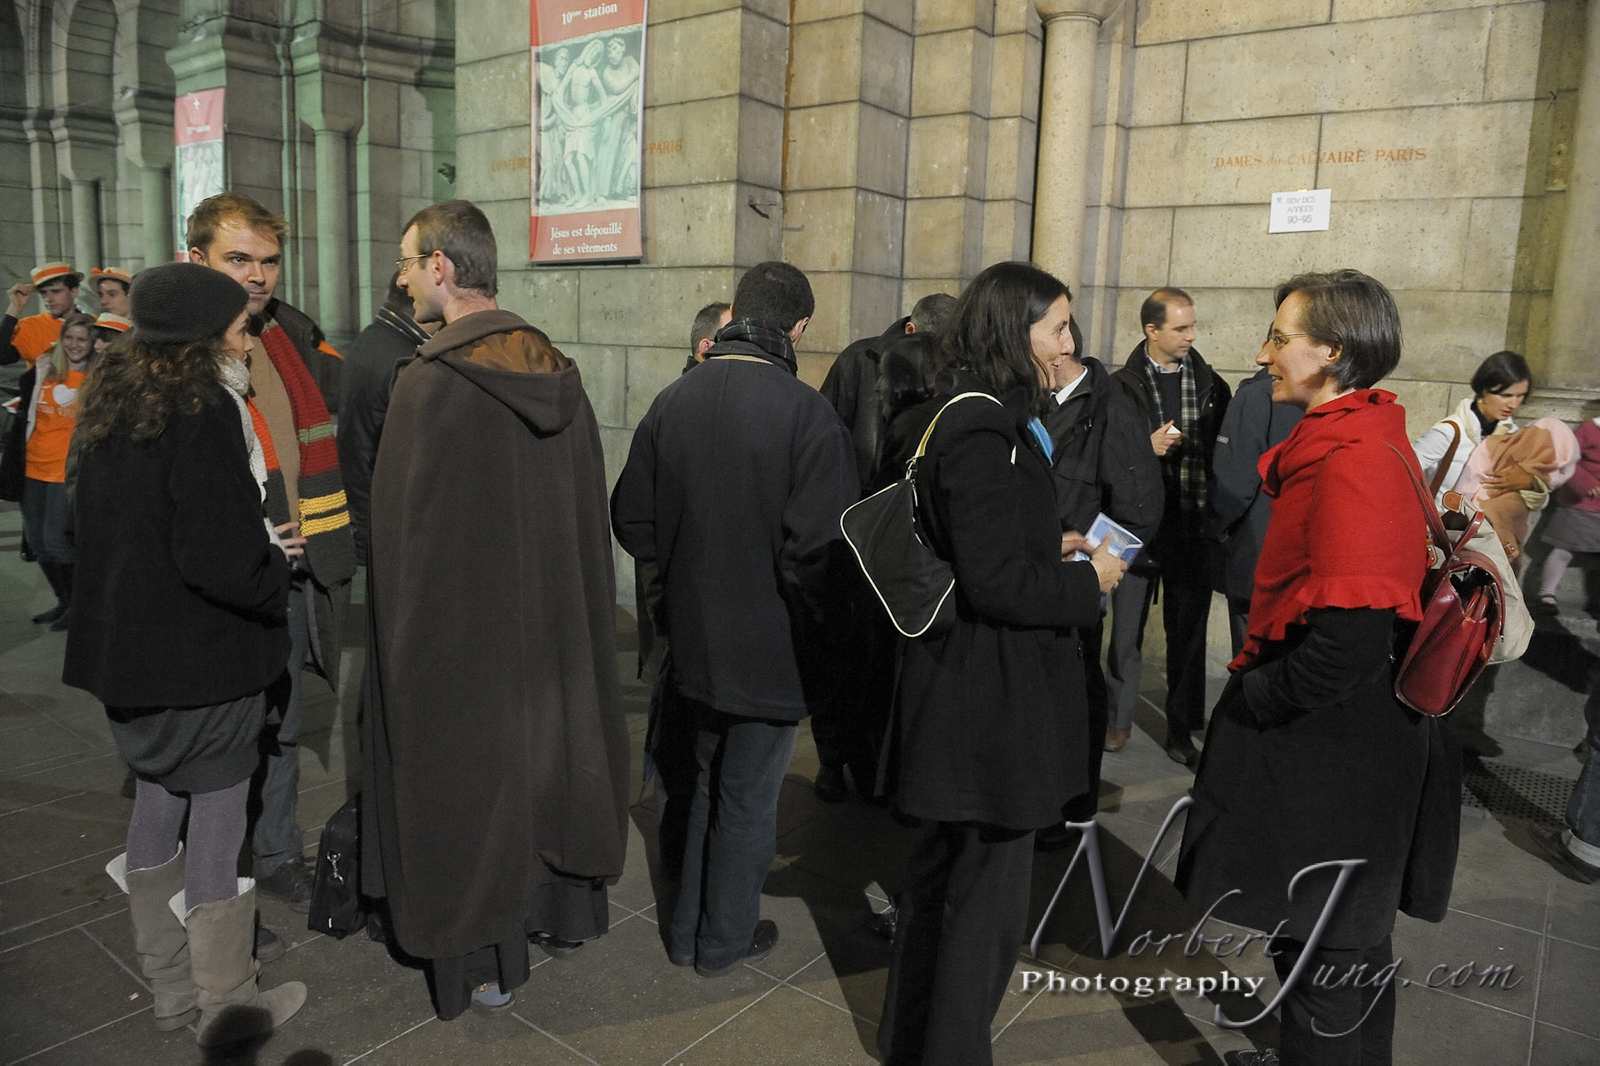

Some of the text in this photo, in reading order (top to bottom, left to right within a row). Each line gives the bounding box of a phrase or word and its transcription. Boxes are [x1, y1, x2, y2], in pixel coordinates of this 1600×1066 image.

[584, 3, 618, 20] station
[1215, 155, 1263, 168] DAMES
[1375, 147, 1427, 162] PARIS
[571, 227, 583, 237] est
[584, 222, 622, 239] dépouillé
[552, 242, 618, 256] de ses vêtements
